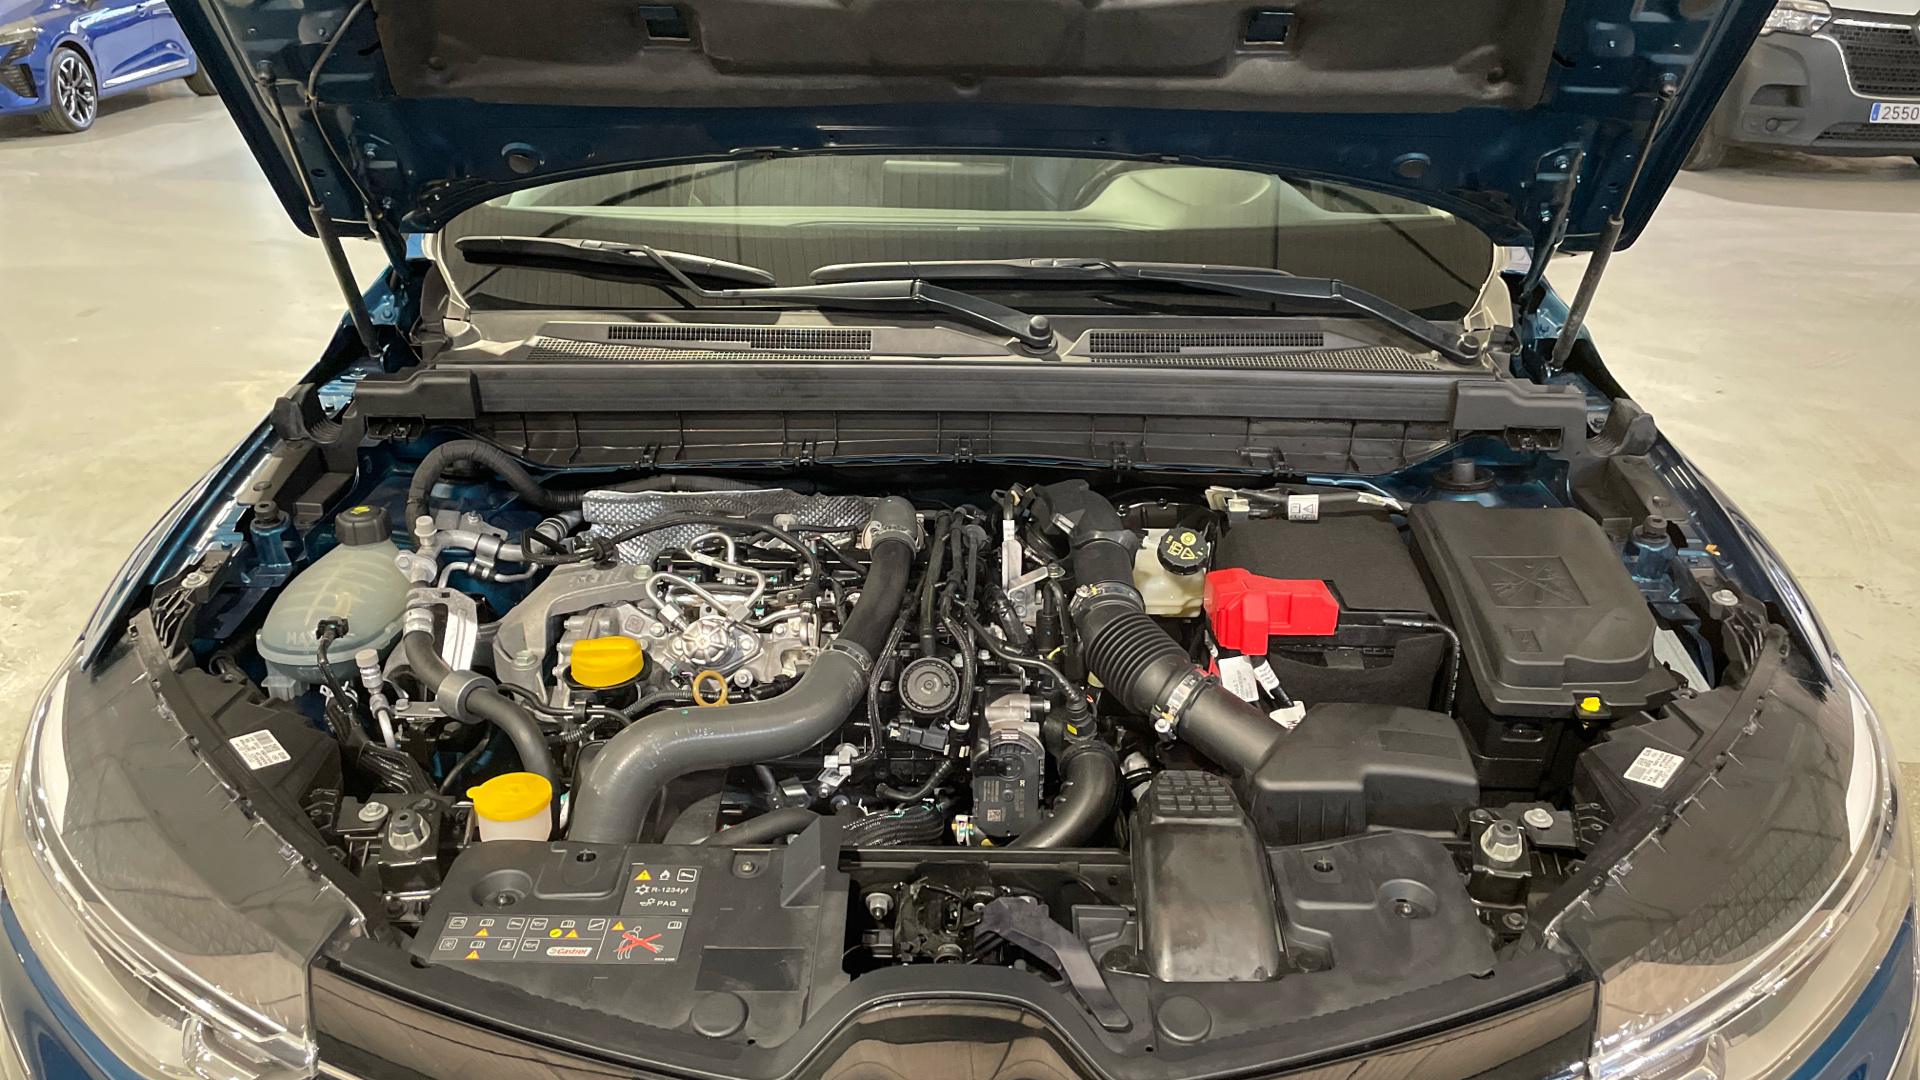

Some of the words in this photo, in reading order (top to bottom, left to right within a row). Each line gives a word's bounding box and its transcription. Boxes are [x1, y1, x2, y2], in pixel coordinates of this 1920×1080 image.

[1881, 106, 1919, 120] 2550
[651, 886, 689, 895] R-1234yf
[557, 947, 588, 955] Castrol
